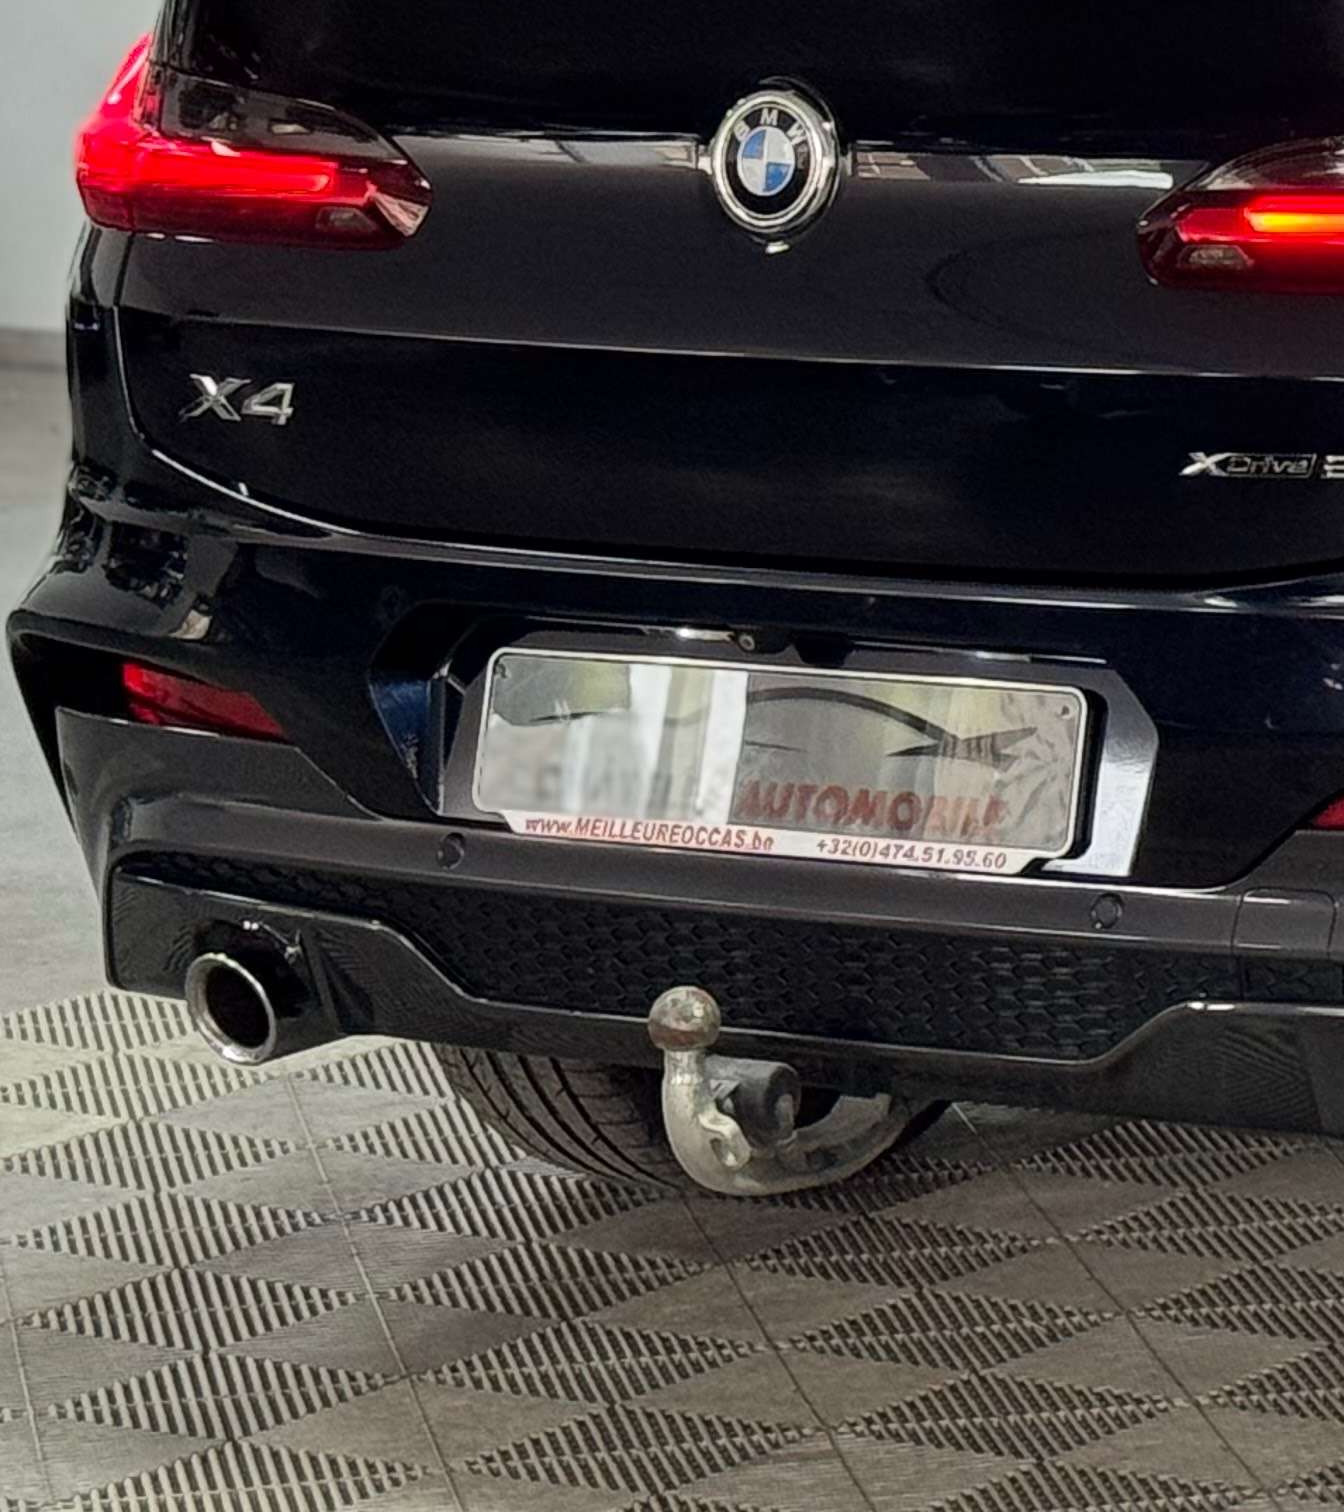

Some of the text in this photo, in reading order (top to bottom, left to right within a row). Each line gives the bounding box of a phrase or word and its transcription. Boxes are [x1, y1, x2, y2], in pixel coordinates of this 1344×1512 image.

[733, 108, 809, 146] BMW
[178, 373, 296, 426] X4
[816, 838, 1007, 870] +32(0)474.51.95.60
